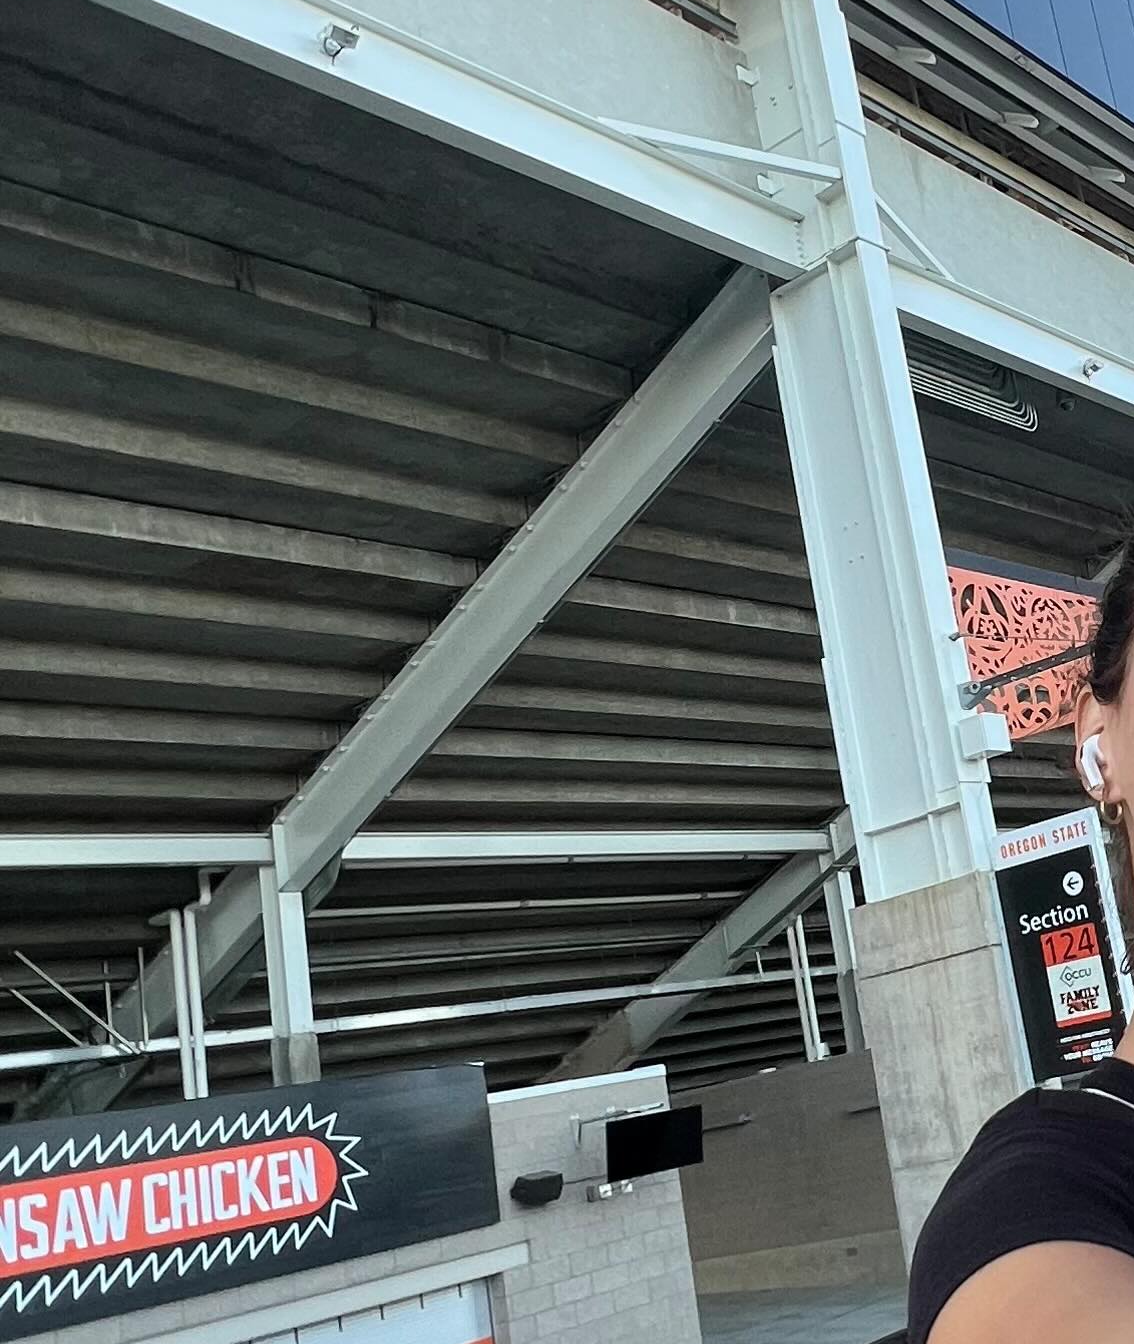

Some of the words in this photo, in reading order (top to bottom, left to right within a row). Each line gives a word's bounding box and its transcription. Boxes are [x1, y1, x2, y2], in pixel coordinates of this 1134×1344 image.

[1000, 833, 1047, 859] OREGON
[1051, 820, 1088, 844] STATE
[1019, 903, 1090, 935] Section
[1045, 927, 1095, 965] 124
[1060, 984, 1100, 1005] FAMILY
[142, 1147, 318, 1235] CHICKEN
